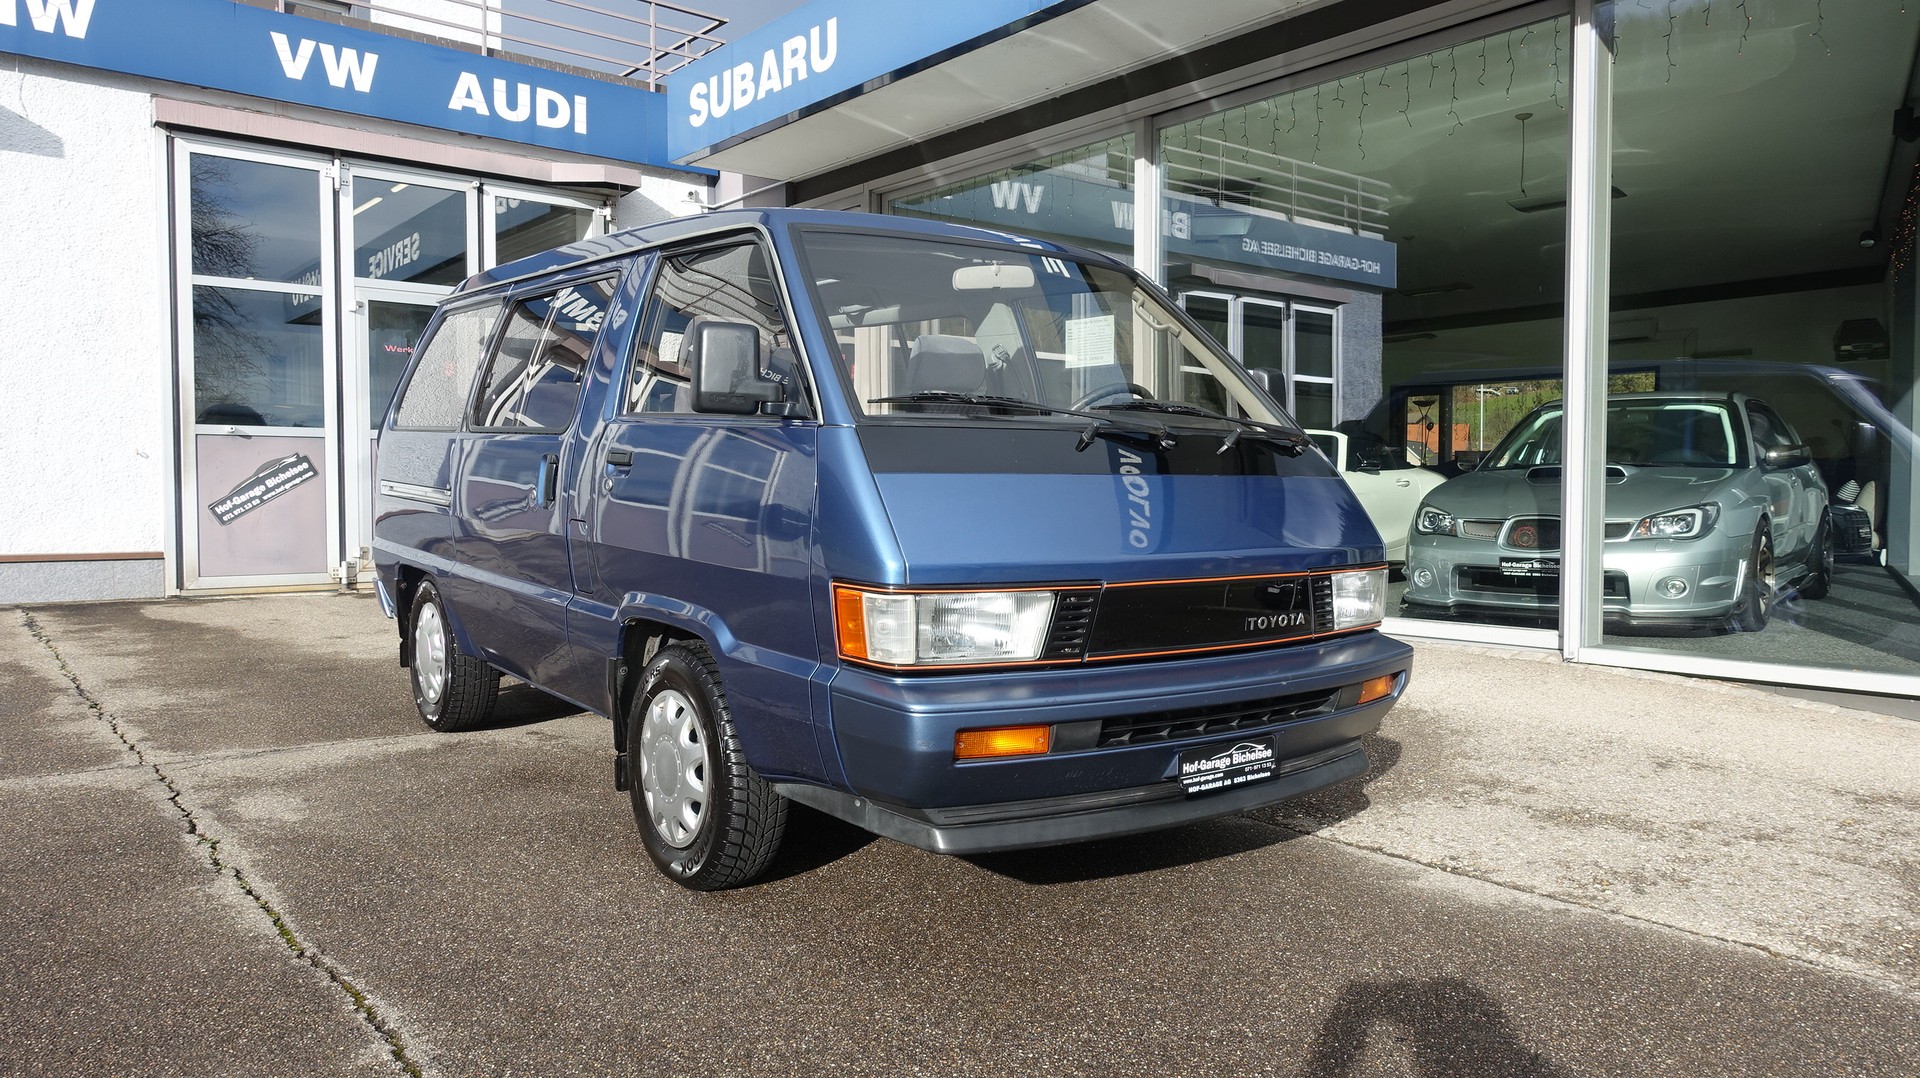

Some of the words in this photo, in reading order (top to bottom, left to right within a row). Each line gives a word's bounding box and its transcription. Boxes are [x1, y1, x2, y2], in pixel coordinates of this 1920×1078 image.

[269, 31, 379, 93] VW
[689, 16, 838, 128] SUBARU
[448, 71, 587, 134] AUDI
[214, 484, 266, 515] Hof-Garage
[265, 462, 309, 489] Bichelsee
[1248, 612, 1306, 631] TOYOTA
[1182, 758, 1231, 774] Hof-Garage
[1232, 748, 1272, 765] Bichelsee
[1188, 780, 1223, 793] HOF-GARAGE
